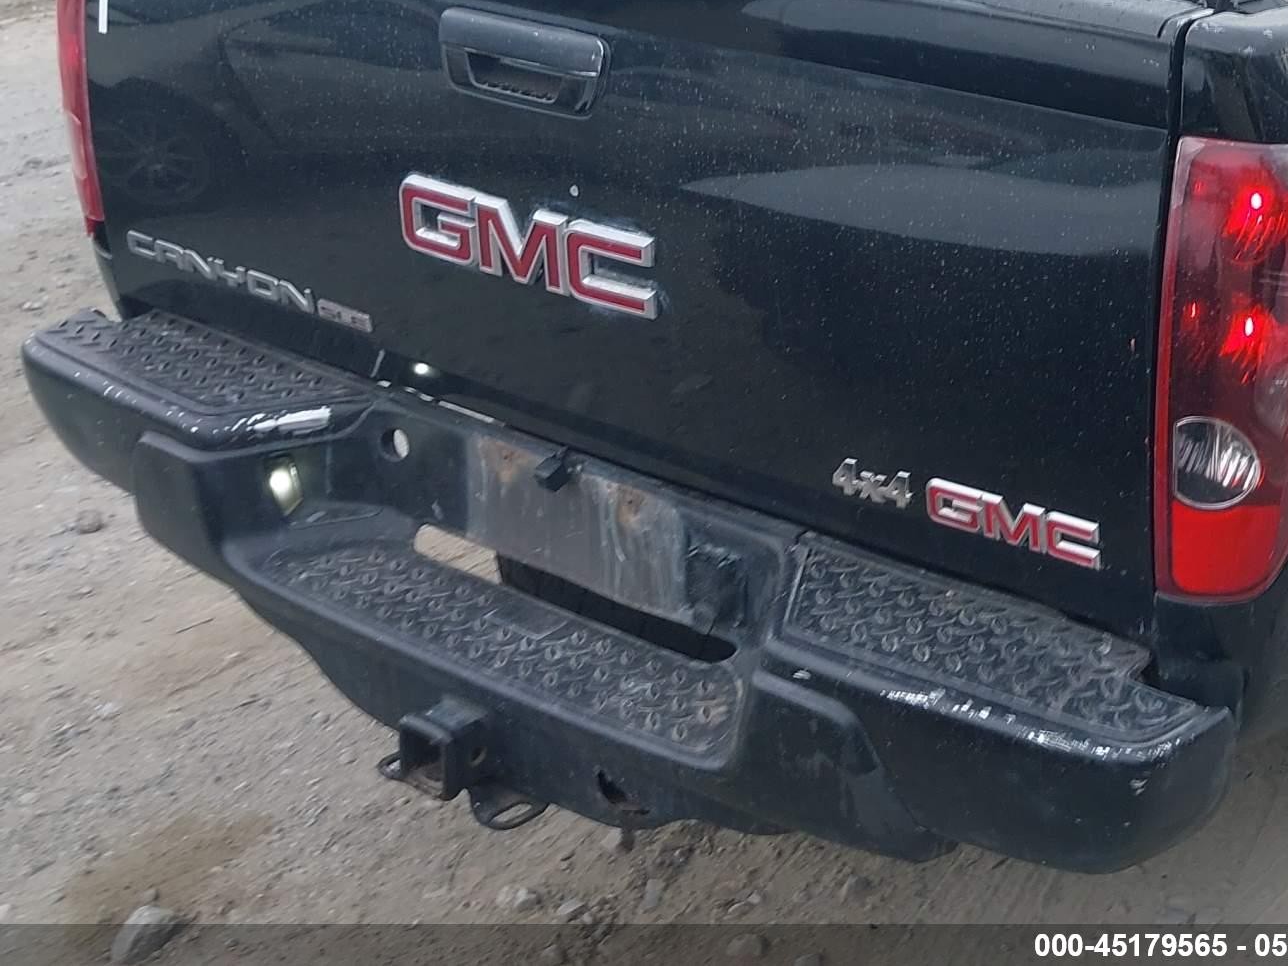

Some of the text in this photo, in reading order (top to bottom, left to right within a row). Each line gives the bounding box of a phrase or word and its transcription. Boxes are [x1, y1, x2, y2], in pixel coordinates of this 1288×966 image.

[126, 229, 315, 314] CANYON
[399, 172, 657, 320] GMC
[926, 477, 1100, 570] GMC
